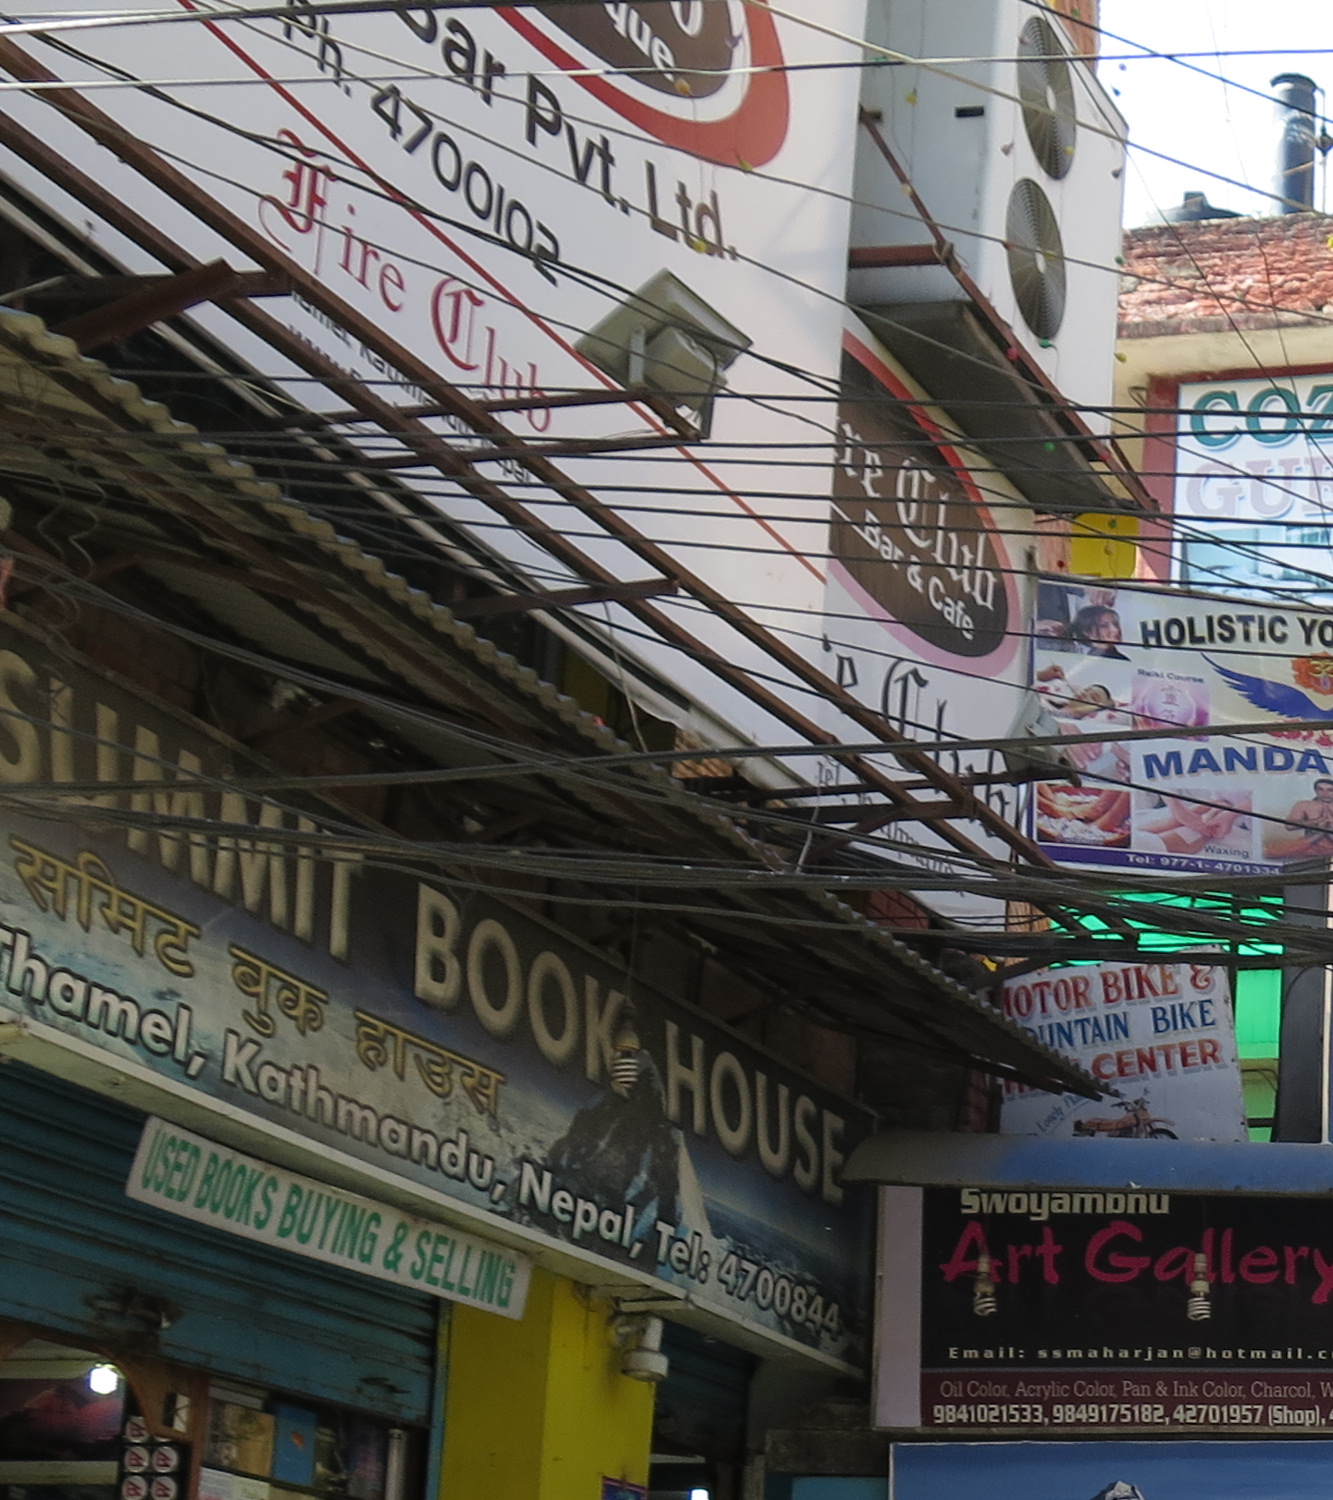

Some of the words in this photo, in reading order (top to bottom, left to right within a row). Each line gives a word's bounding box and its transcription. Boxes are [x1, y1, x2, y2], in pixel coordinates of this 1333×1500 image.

[370, 84, 558, 287] 4700102
[525, 72, 631, 216] Pvt.
[645, 160, 738, 261] Ltd.
[862, 509, 903, 572] Bar
[927, 579, 975, 642] Cafe
[1140, 614, 1290, 650] HOLISTIC
[228, 942, 329, 1039] बुक
[1152, 999, 1217, 1035] BIKE
[1091, 1037, 1222, 1080] CENTER
[664, 1018, 846, 1200] HOUSE
[142, 1128, 193, 1199] USED
[198, 1147, 275, 1234] BOOKS
[279, 1178, 377, 1269] BUYING
[382, 1219, 408, 1271] &
[411, 1228, 518, 1311] SELLING
[222, 1028, 508, 1204] Kathmandu,
[517, 1160, 644, 1261] Nepal,
[716, 1250, 842, 1344] 4700844
[939, 1221, 1063, 1287] Art
[940, 1380, 963, 1398] Oil
[965, 1379, 1011, 1401] Color,
[1014, 1379, 1070, 1401] Acrylic
[1072, 1379, 1118, 1401] Color,
[1122, 1381, 1151, 1398] Pan
[1153, 1381, 1168, 1398] &
[1171, 1380, 1199, 1398] Ink
[1202, 1380, 1247, 1401] Color,
[1250, 1380, 1316, 1401] Charcol,
[947, 1345, 1026, 1361] Email:
[932, 1403, 1050, 1426] 9841021533,
[1052, 1403, 1170, 1426] 9849175182,
[1172, 1403, 1264, 1424] 42701957
[1266, 1403, 1326, 1428] (Shop),
